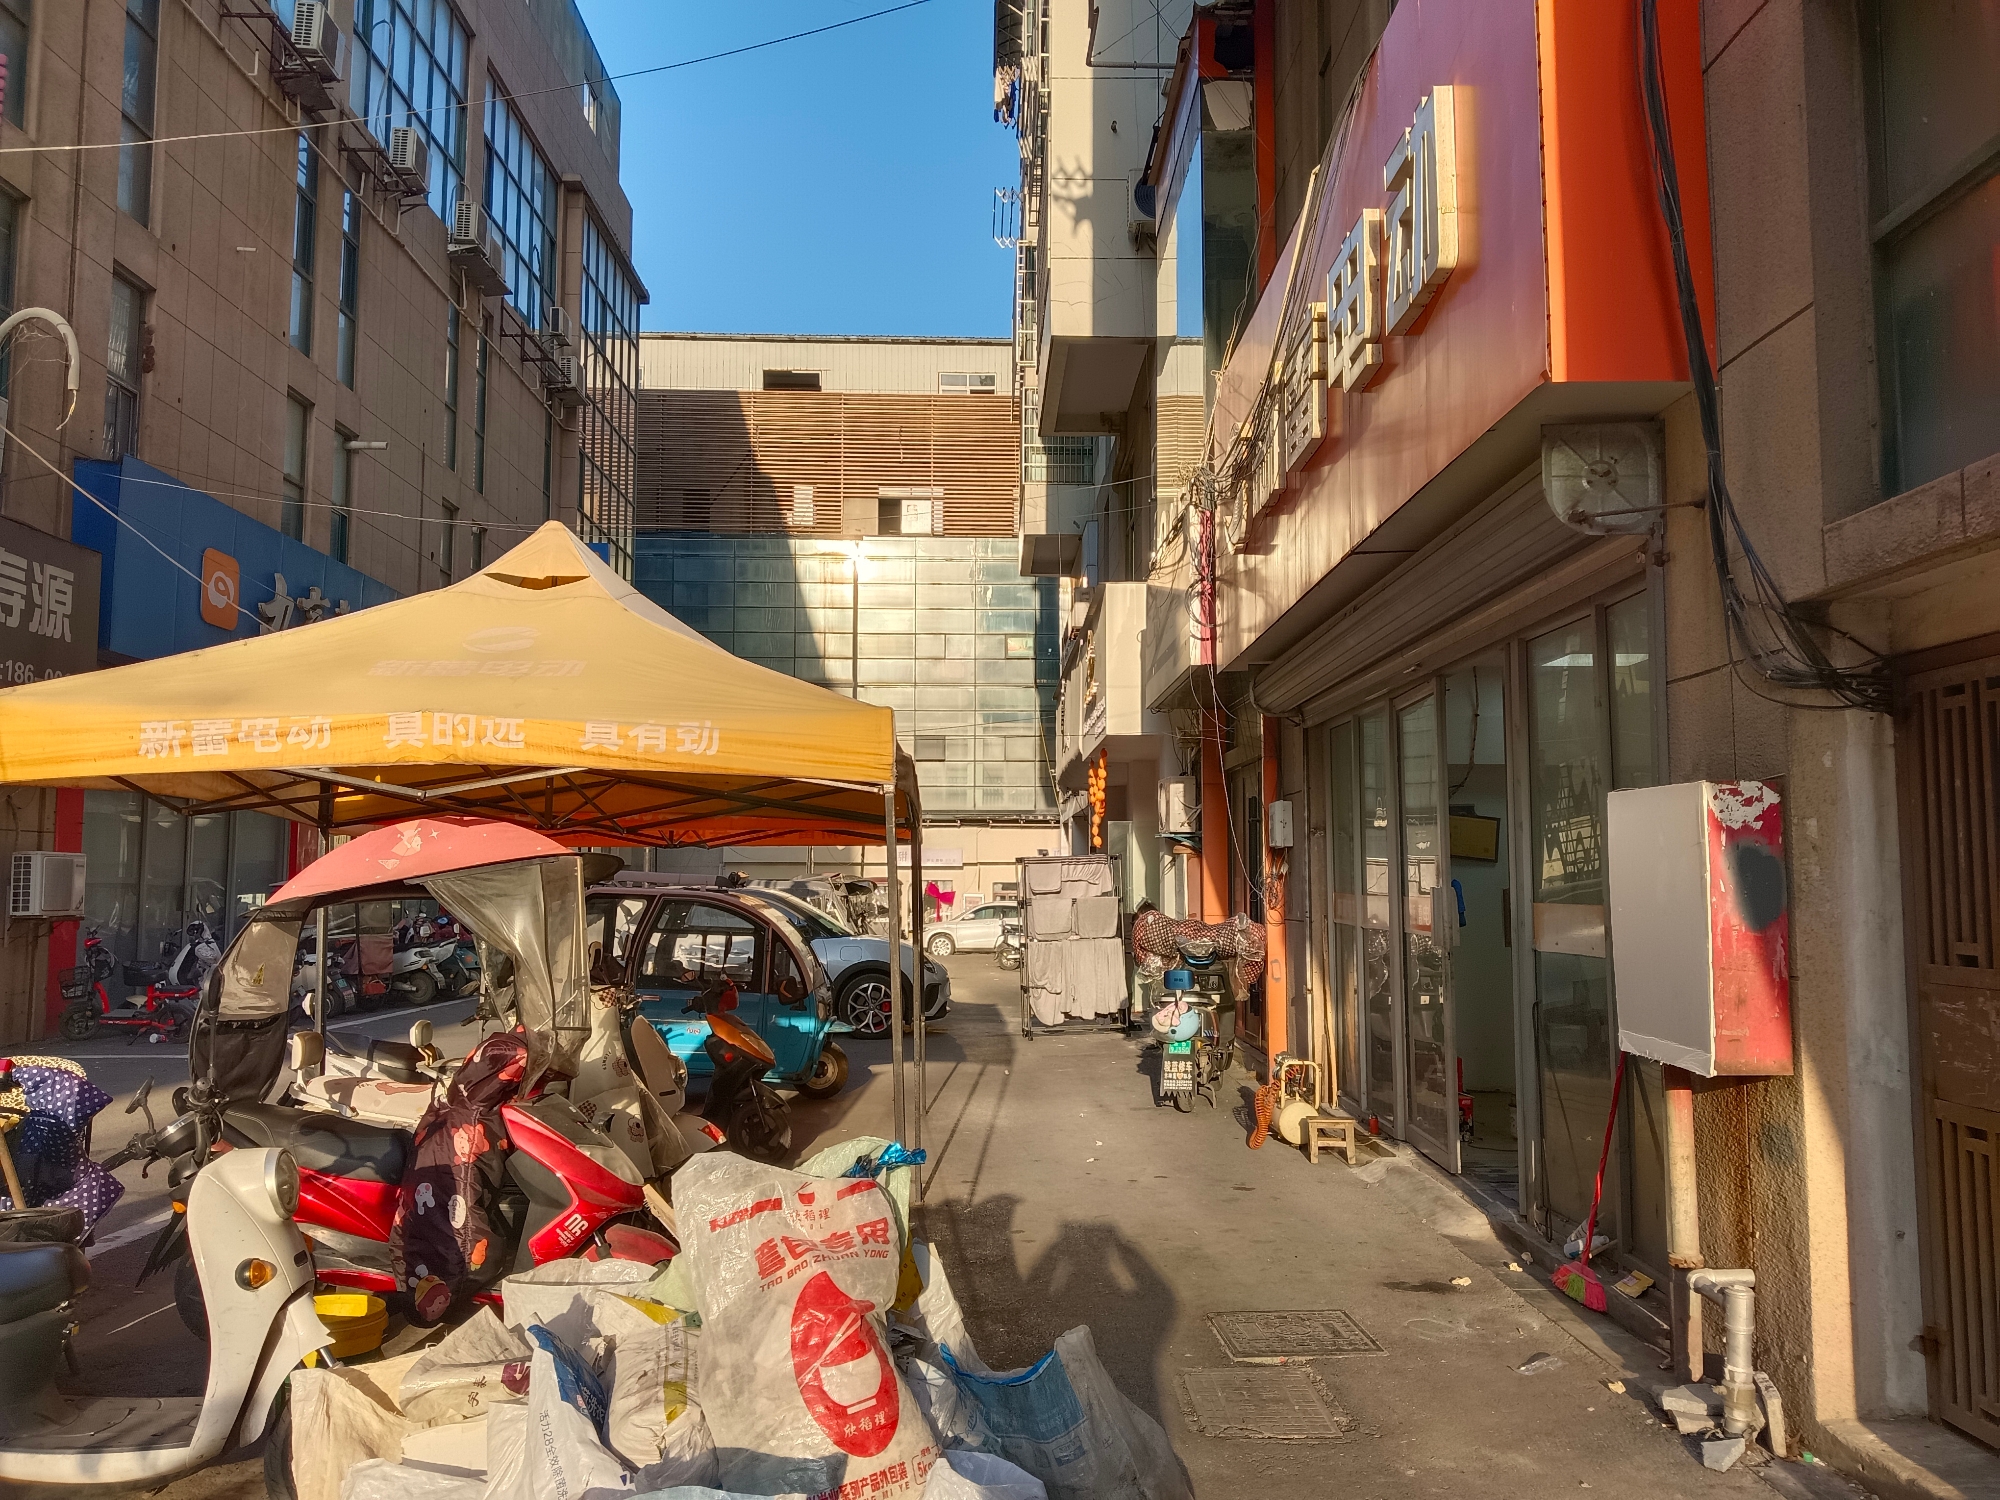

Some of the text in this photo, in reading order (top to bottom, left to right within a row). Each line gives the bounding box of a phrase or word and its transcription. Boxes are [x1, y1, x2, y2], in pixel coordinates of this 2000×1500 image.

[760, 1276, 783, 1292] TAO
[787, 1260, 809, 1280] BAO
[863, 1249, 889, 1259] YONG
[540, 1409, 568, 1500] 活力28全效除菌洗
